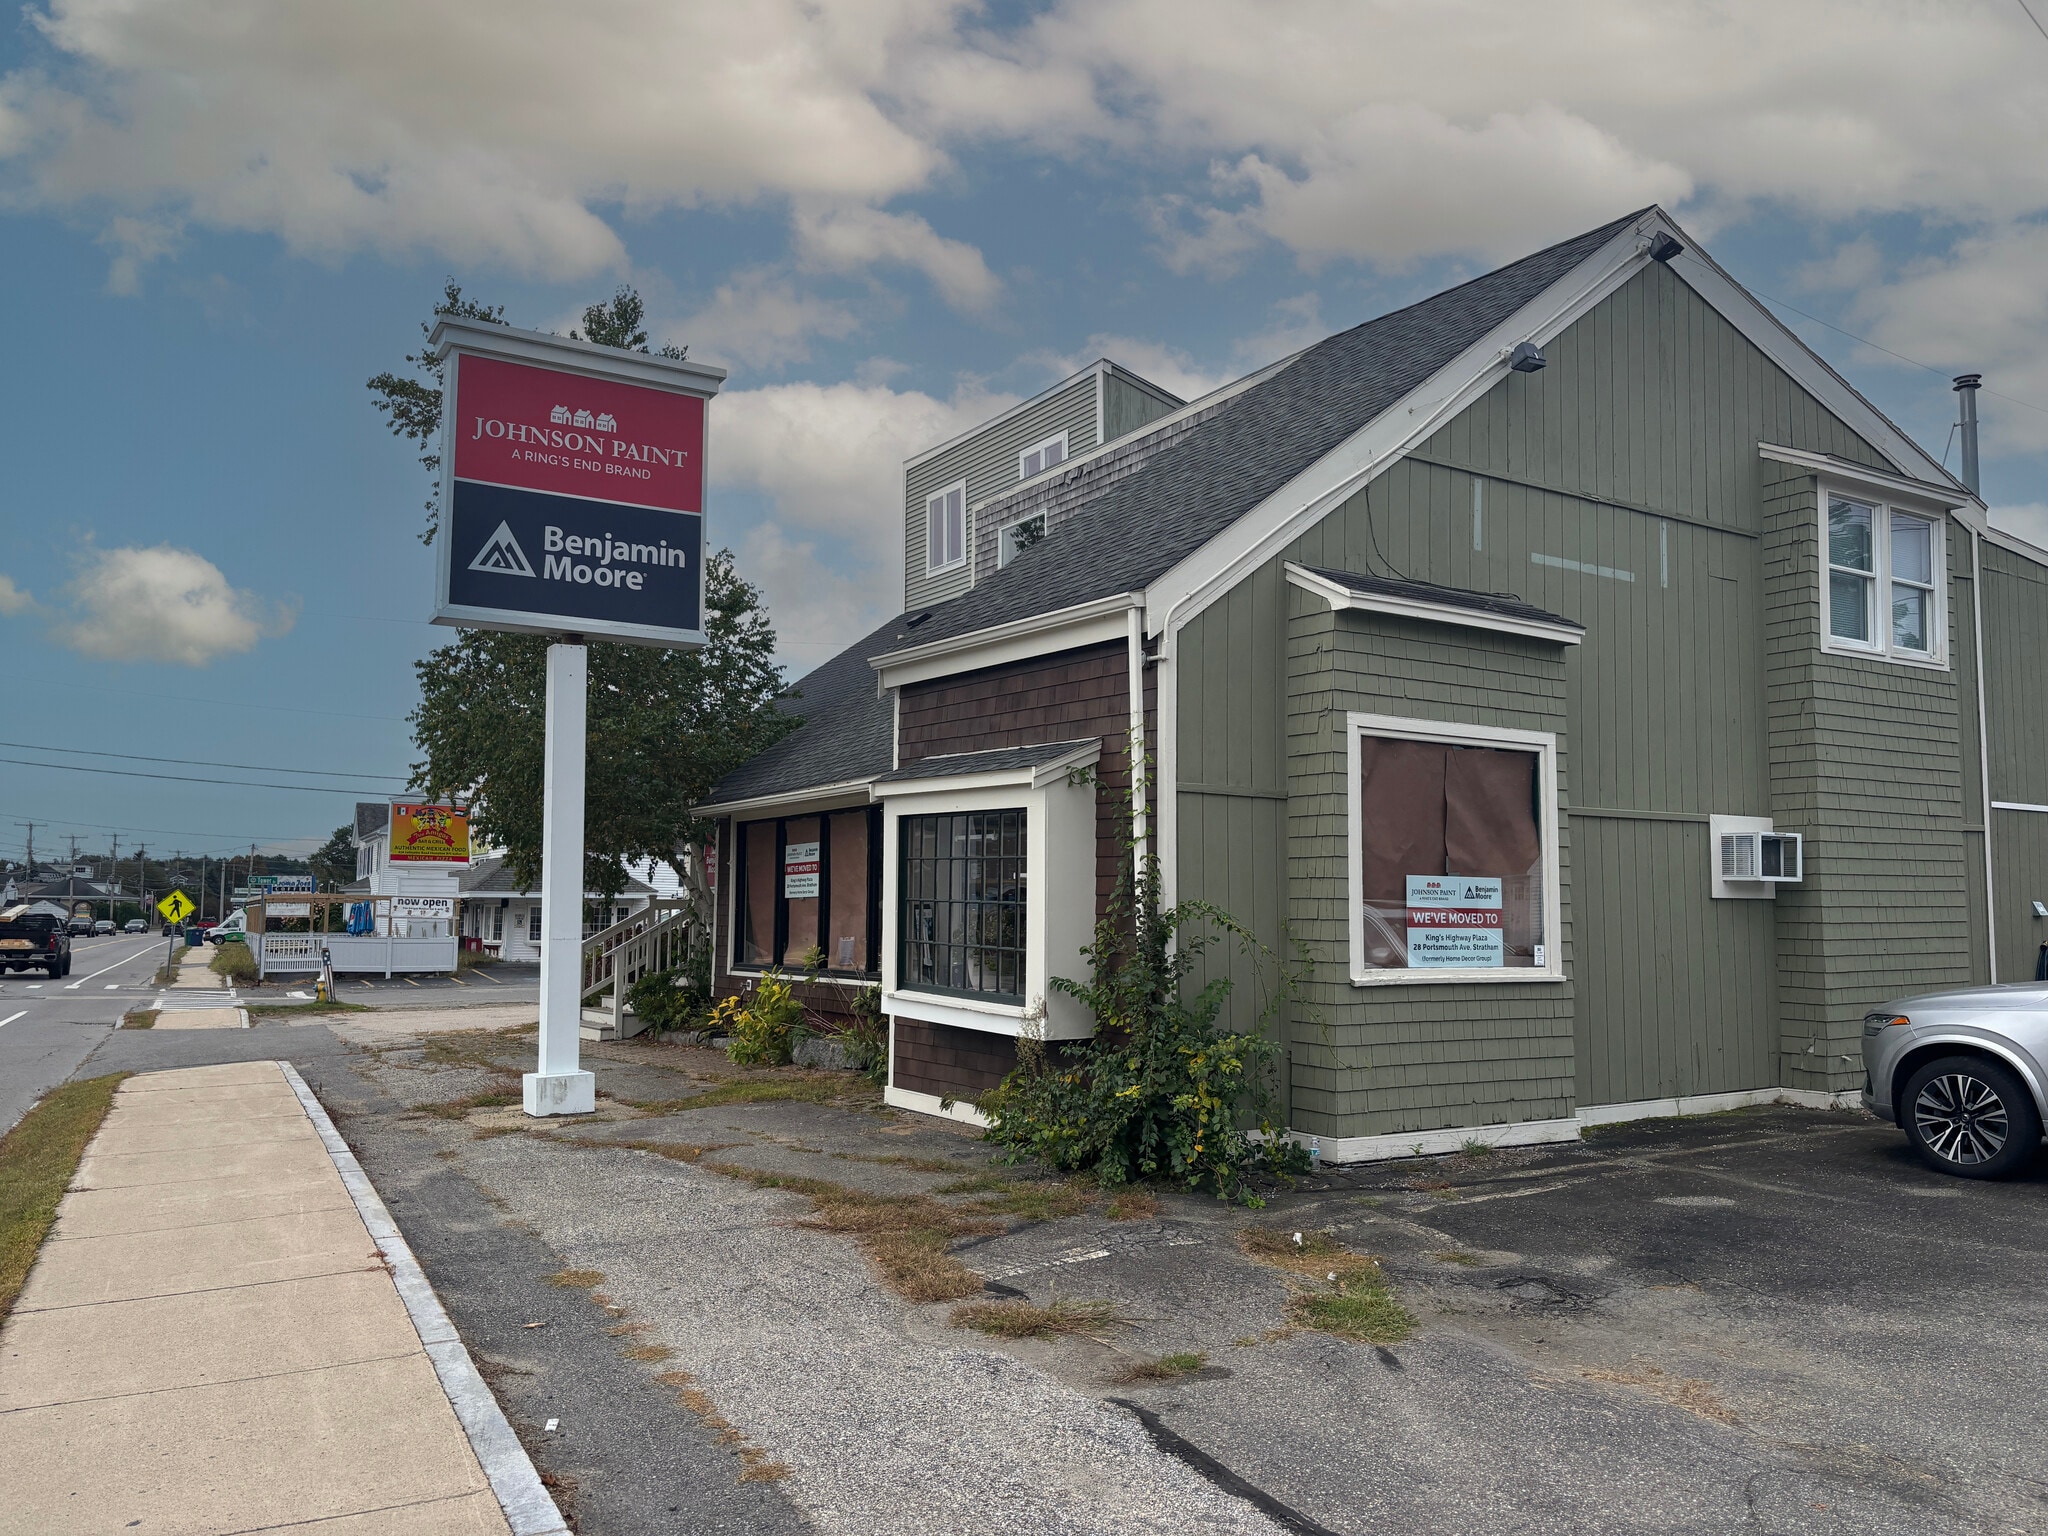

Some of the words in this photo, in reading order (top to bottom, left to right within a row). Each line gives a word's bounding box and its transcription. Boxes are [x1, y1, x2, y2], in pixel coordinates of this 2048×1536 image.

[471, 416, 605, 456] JOHNSON
[611, 439, 688, 468] PAINT
[511, 448, 521, 460] A
[524, 451, 570, 468] RING'S
[573, 458, 602, 473] END
[605, 463, 651, 480] BRAND
[543, 525, 686, 569] Benjamin
[543, 554, 644, 591] Moore
[1475, 886, 1498, 894] Benjamin
[422, 898, 448, 908] open
[1412, 912, 1447, 924] WE'VE
[1449, 912, 1484, 924] MOVED
[1485, 913, 1498, 924] TO
[1425, 934, 1444, 942] King's
[1445, 934, 1471, 943] Highway
[1422, 943, 1458, 951] Portsmouth
